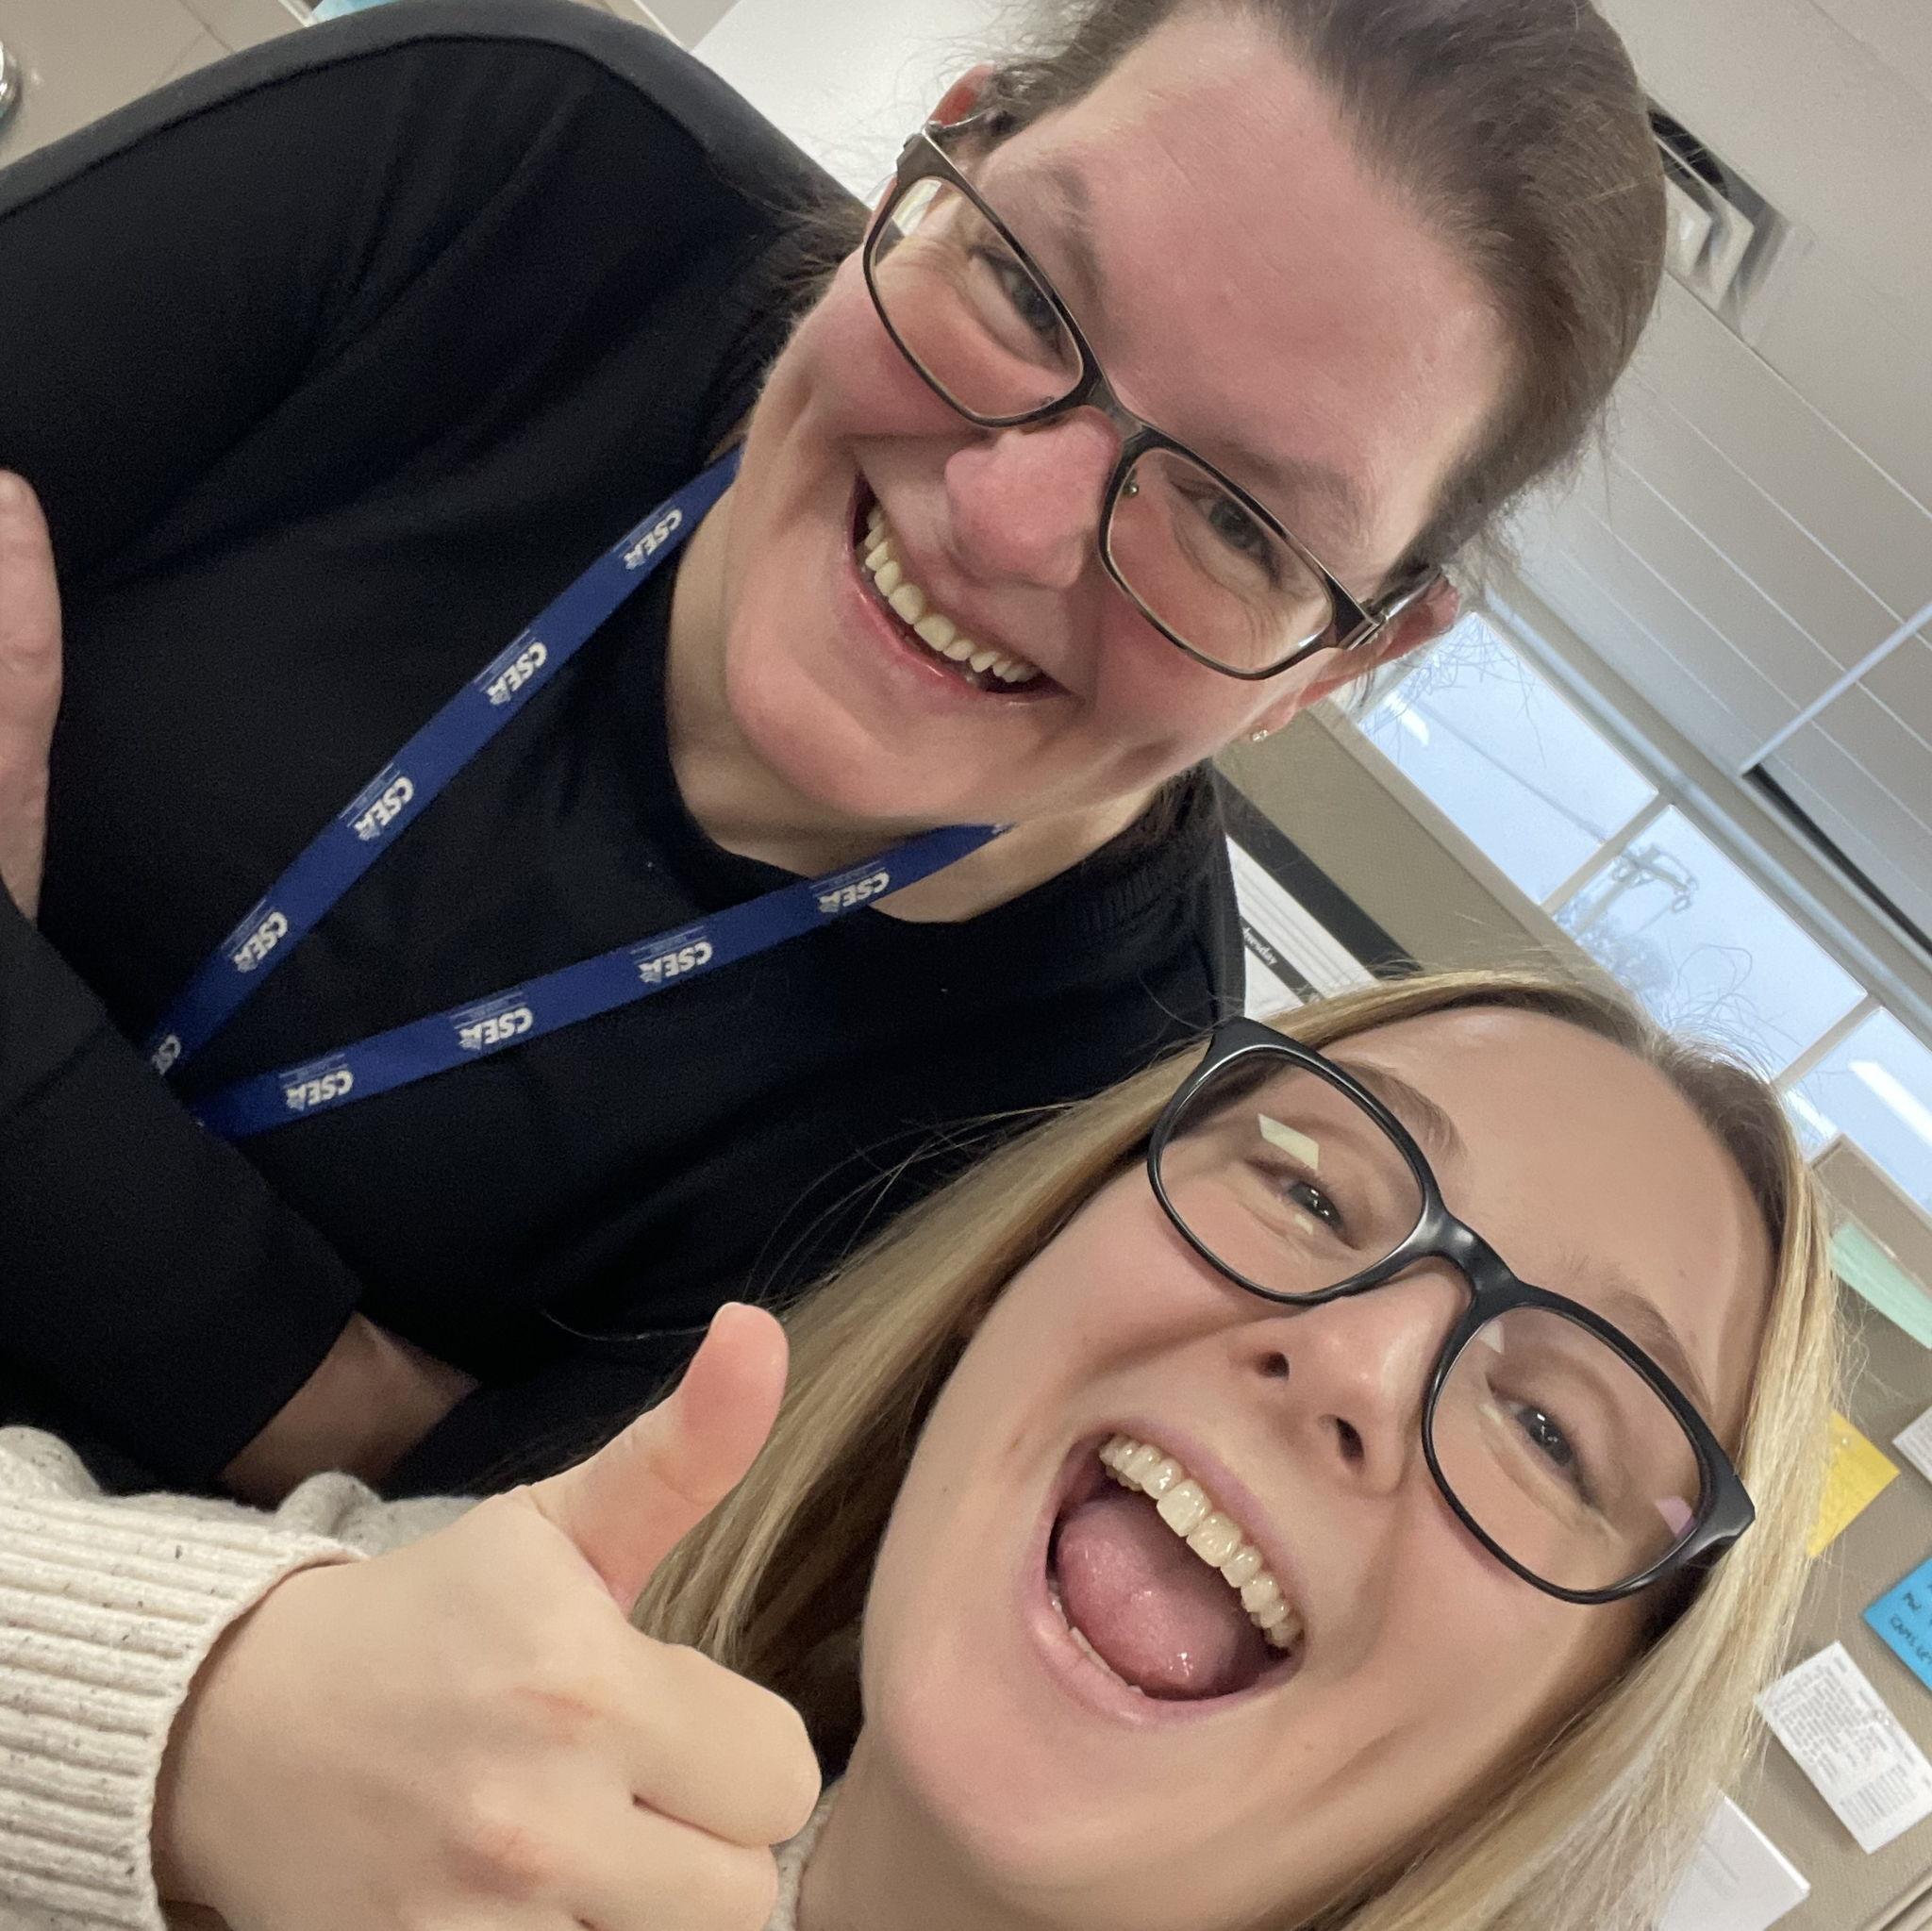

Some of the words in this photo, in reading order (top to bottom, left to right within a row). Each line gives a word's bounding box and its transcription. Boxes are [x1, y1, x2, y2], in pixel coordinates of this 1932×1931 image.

[624, 509, 682, 570] CSEA
[487, 642, 547, 705] CSEA
[354, 776, 414, 841] CSEA
[817, 872, 891, 912] CSEA
[234, 911, 288, 973] CSEA
[637, 941, 713, 982] CSEA
[1242, 927, 1277, 966] dnesday
[458, 1007, 533, 1051] CSEA
[285, 1070, 354, 1111] CSEA
